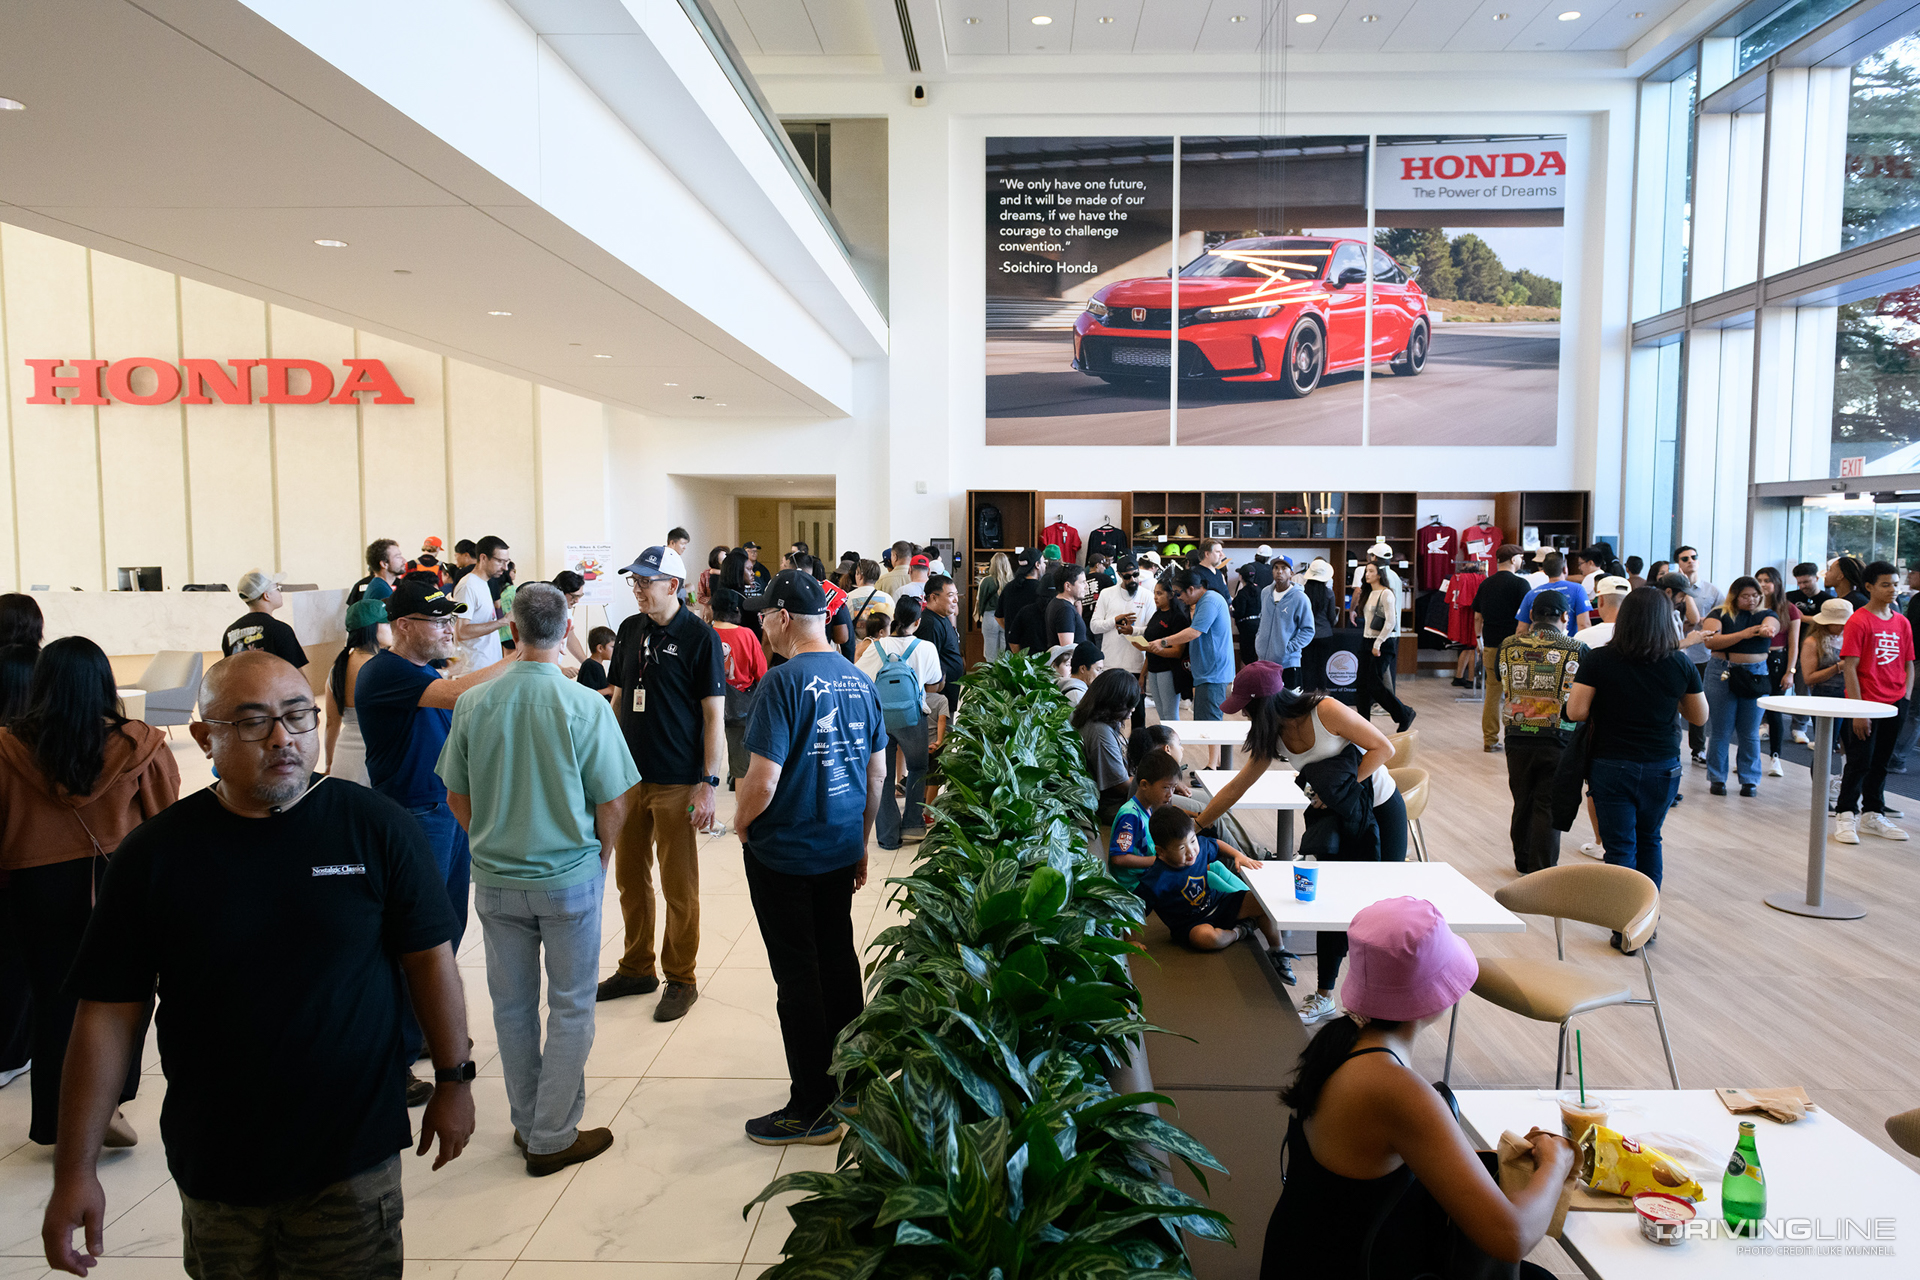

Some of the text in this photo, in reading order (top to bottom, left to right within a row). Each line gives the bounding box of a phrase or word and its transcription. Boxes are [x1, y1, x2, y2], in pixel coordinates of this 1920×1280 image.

[1400, 151, 1566, 180] HONDA
[1000, 178, 1147, 192] “We only have one future,
[1412, 185, 1557, 198] The Power of Dreams
[999, 193, 1145, 205] and it will be made of our
[999, 209, 1128, 222] dreams, if we have the
[999, 225, 1119, 239] courage to challenge
[998, 240, 1071, 252] convention.”
[998, 261, 1098, 274] -Soichiro Honda
[24, 356, 415, 406] HONDA
[1841, 458, 1863, 477] EXIT
[832, 680, 847, 688] Ride
[847, 680, 857, 688] for
[1188, 885, 1203, 899] LA
